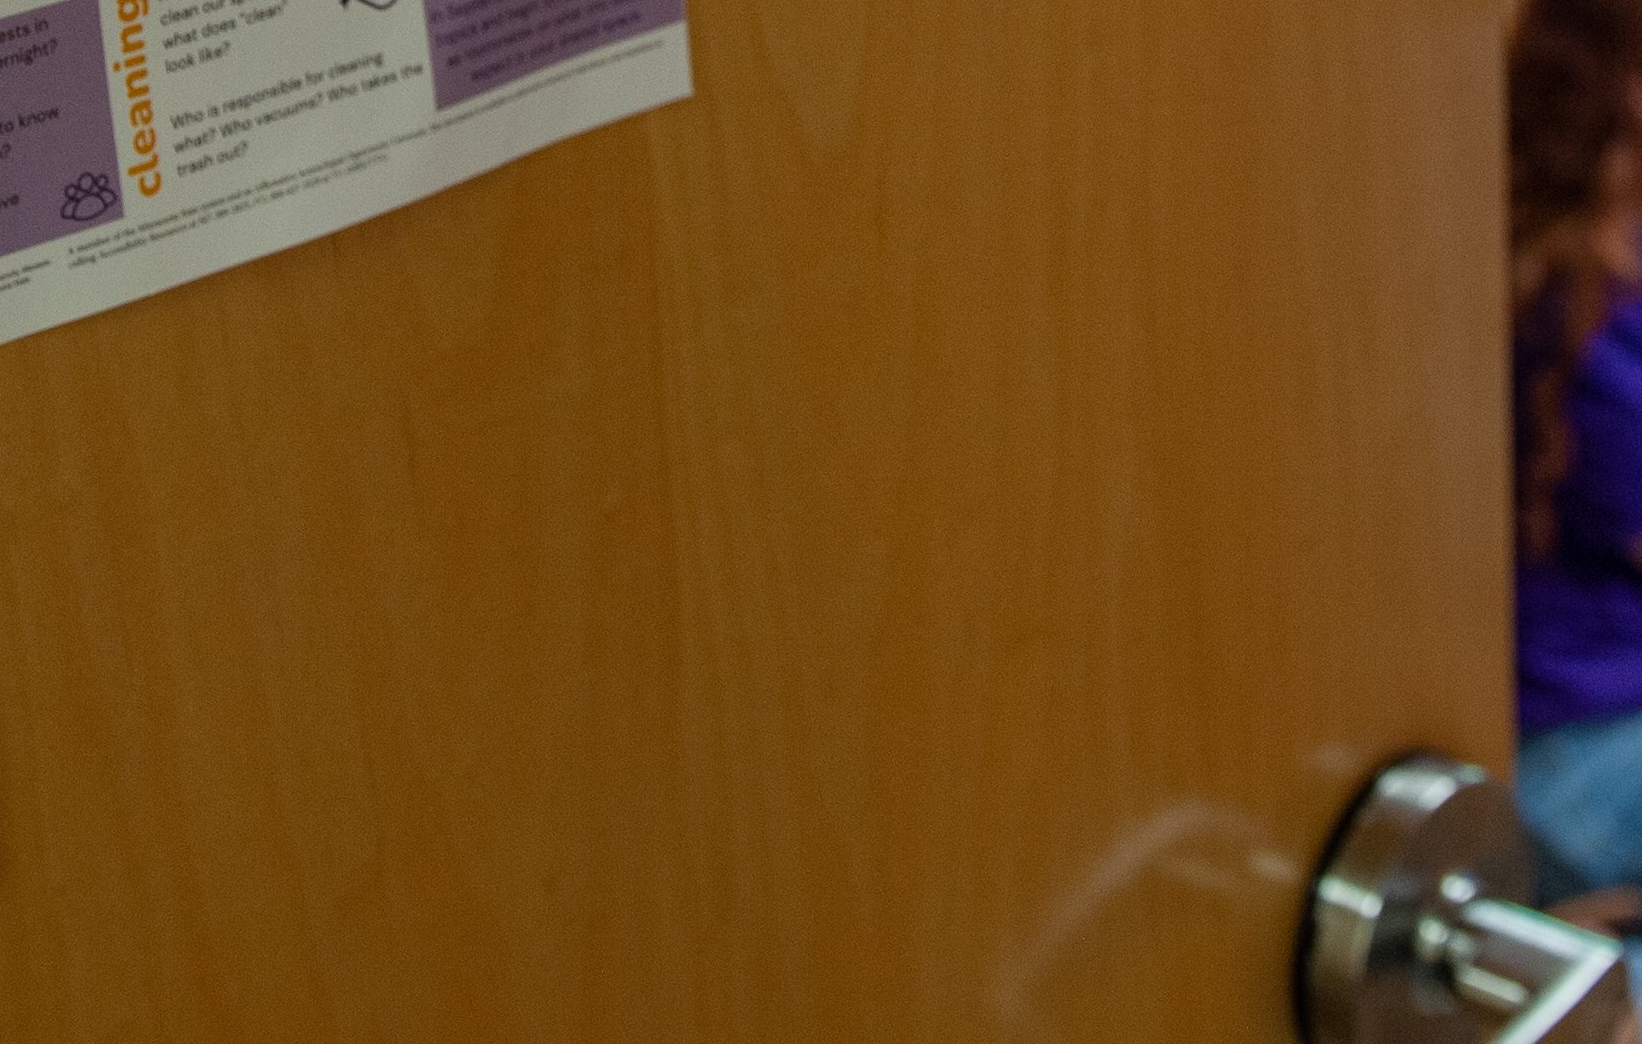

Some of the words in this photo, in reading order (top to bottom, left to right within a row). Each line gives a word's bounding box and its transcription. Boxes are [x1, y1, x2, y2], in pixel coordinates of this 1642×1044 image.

[33, 17, 50, 33] in
[159, 4, 199, 26] clean
[162, 28, 198, 50] what
[200, 18, 237, 38] does
[169, 109, 205, 130] Who
[206, 104, 220, 118] is
[221, 77, 303, 112] responsible
[303, 70, 325, 85] for
[327, 51, 384, 79] cleaning
[16, 106, 60, 128] know
